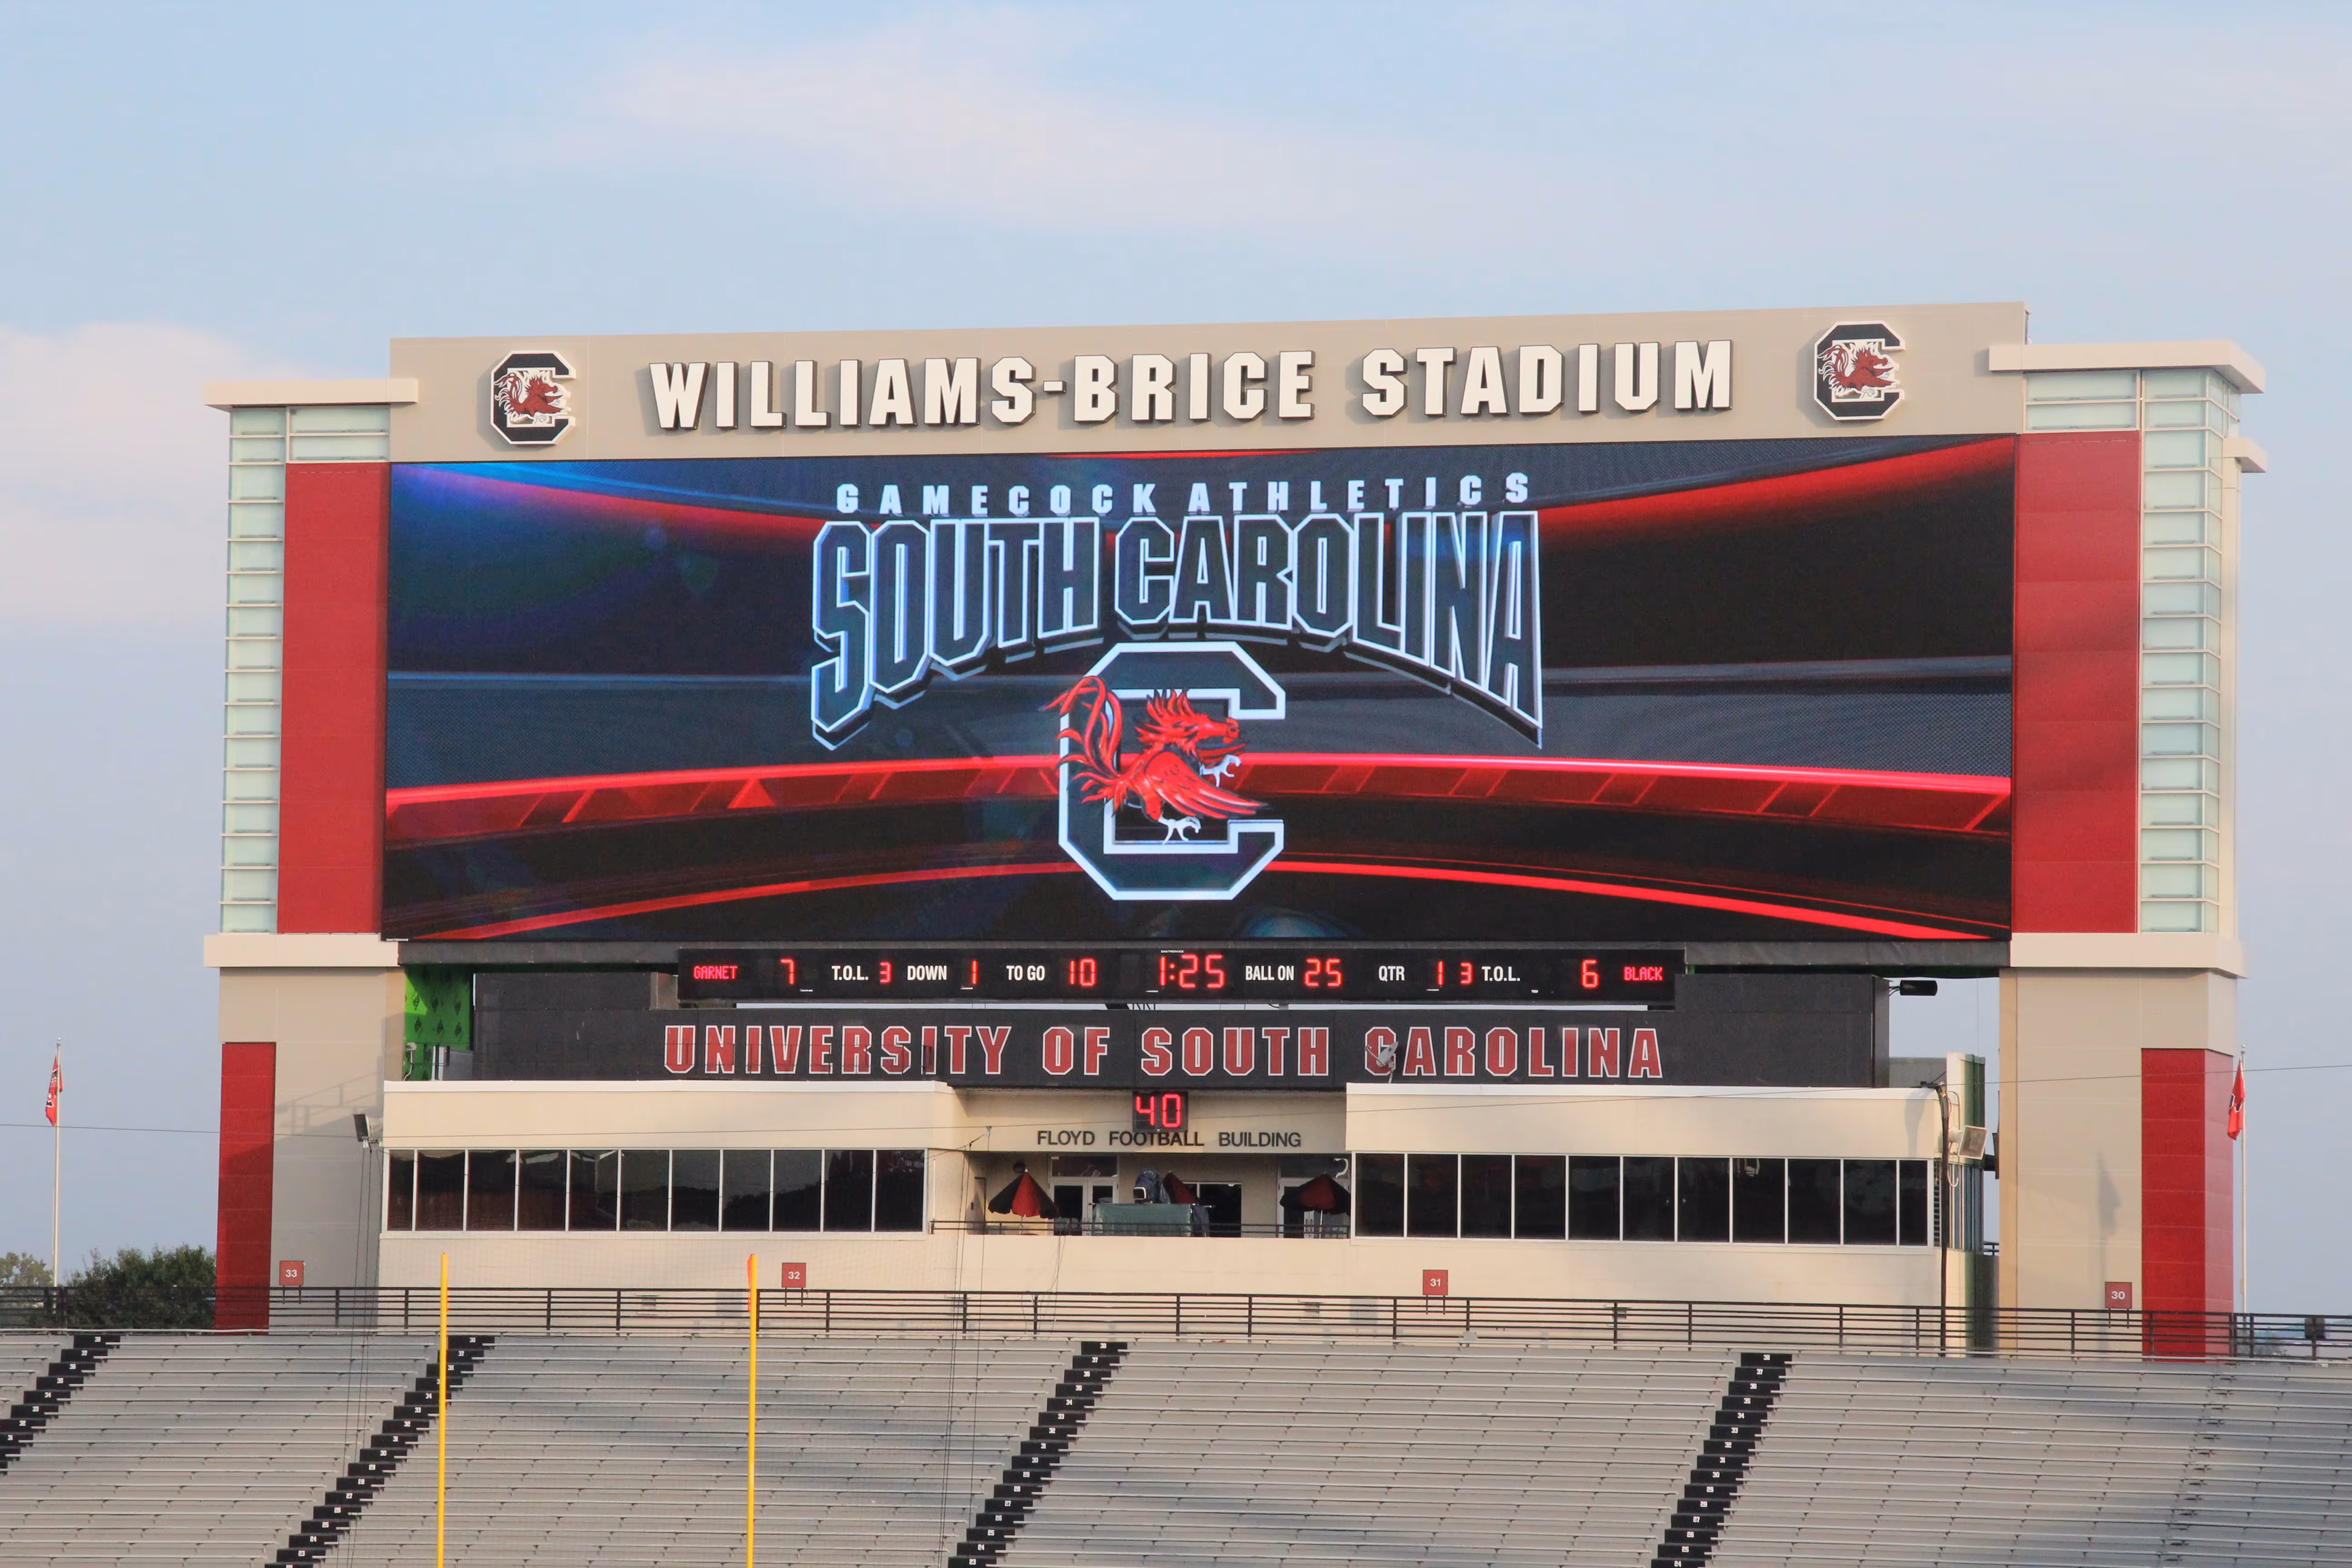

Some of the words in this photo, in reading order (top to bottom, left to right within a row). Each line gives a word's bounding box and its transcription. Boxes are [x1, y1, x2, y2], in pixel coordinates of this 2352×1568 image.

[648, 350, 1315, 430] WILLIAMS-BRICE
[1361, 339, 1733, 419] STADIUM
[837, 483, 1156, 515] GAMECOCK
[1187, 472, 1530, 514] ATHLETICS
[811, 516, 1102, 740] SOUTH
[1114, 510, 1544, 740] CAROLINA
[693, 966, 738, 979] GARNET
[780, 958, 795, 985] 7
[832, 965, 868, 980] T.O.L.
[880, 962, 892, 984] 3
[907, 965, 947, 980] DOWN
[971, 960, 978, 985] 1
[1006, 965, 1023, 980] TO
[1027, 965, 1045, 980] GO
[1069, 958, 1096, 987] 10
[1160, 954, 1225, 989] 1:25
[1245, 965, 1274, 980] BALL
[1278, 965, 1294, 980] ON
[1303, 958, 1343, 987] 25
[1378, 965, 1405, 982] QTR
[1437, 960, 1444, 985] 1
[1460, 962, 1473, 984] 3
[1482, 966, 1520, 981] T.O.L.
[1582, 959, 1599, 988] 6
[1624, 966, 1663, 980] BLACK
[664, 1025, 1012, 1076] UNIVERSITY
[1042, 1026, 1110, 1076] OF
[1141, 1027, 1329, 1077] SOUTH
[1364, 1026, 1663, 1078] CAROLINA
[1136, 1094, 1182, 1128] 40
[1037, 1130, 1095, 1146] FLOYD
[1109, 1132, 1205, 1147] FOOTBALL
[1219, 1132, 1301, 1147] BUILDING
[285, 1269, 297, 1278] 33
[2111, 1291, 2126, 1300] 30
